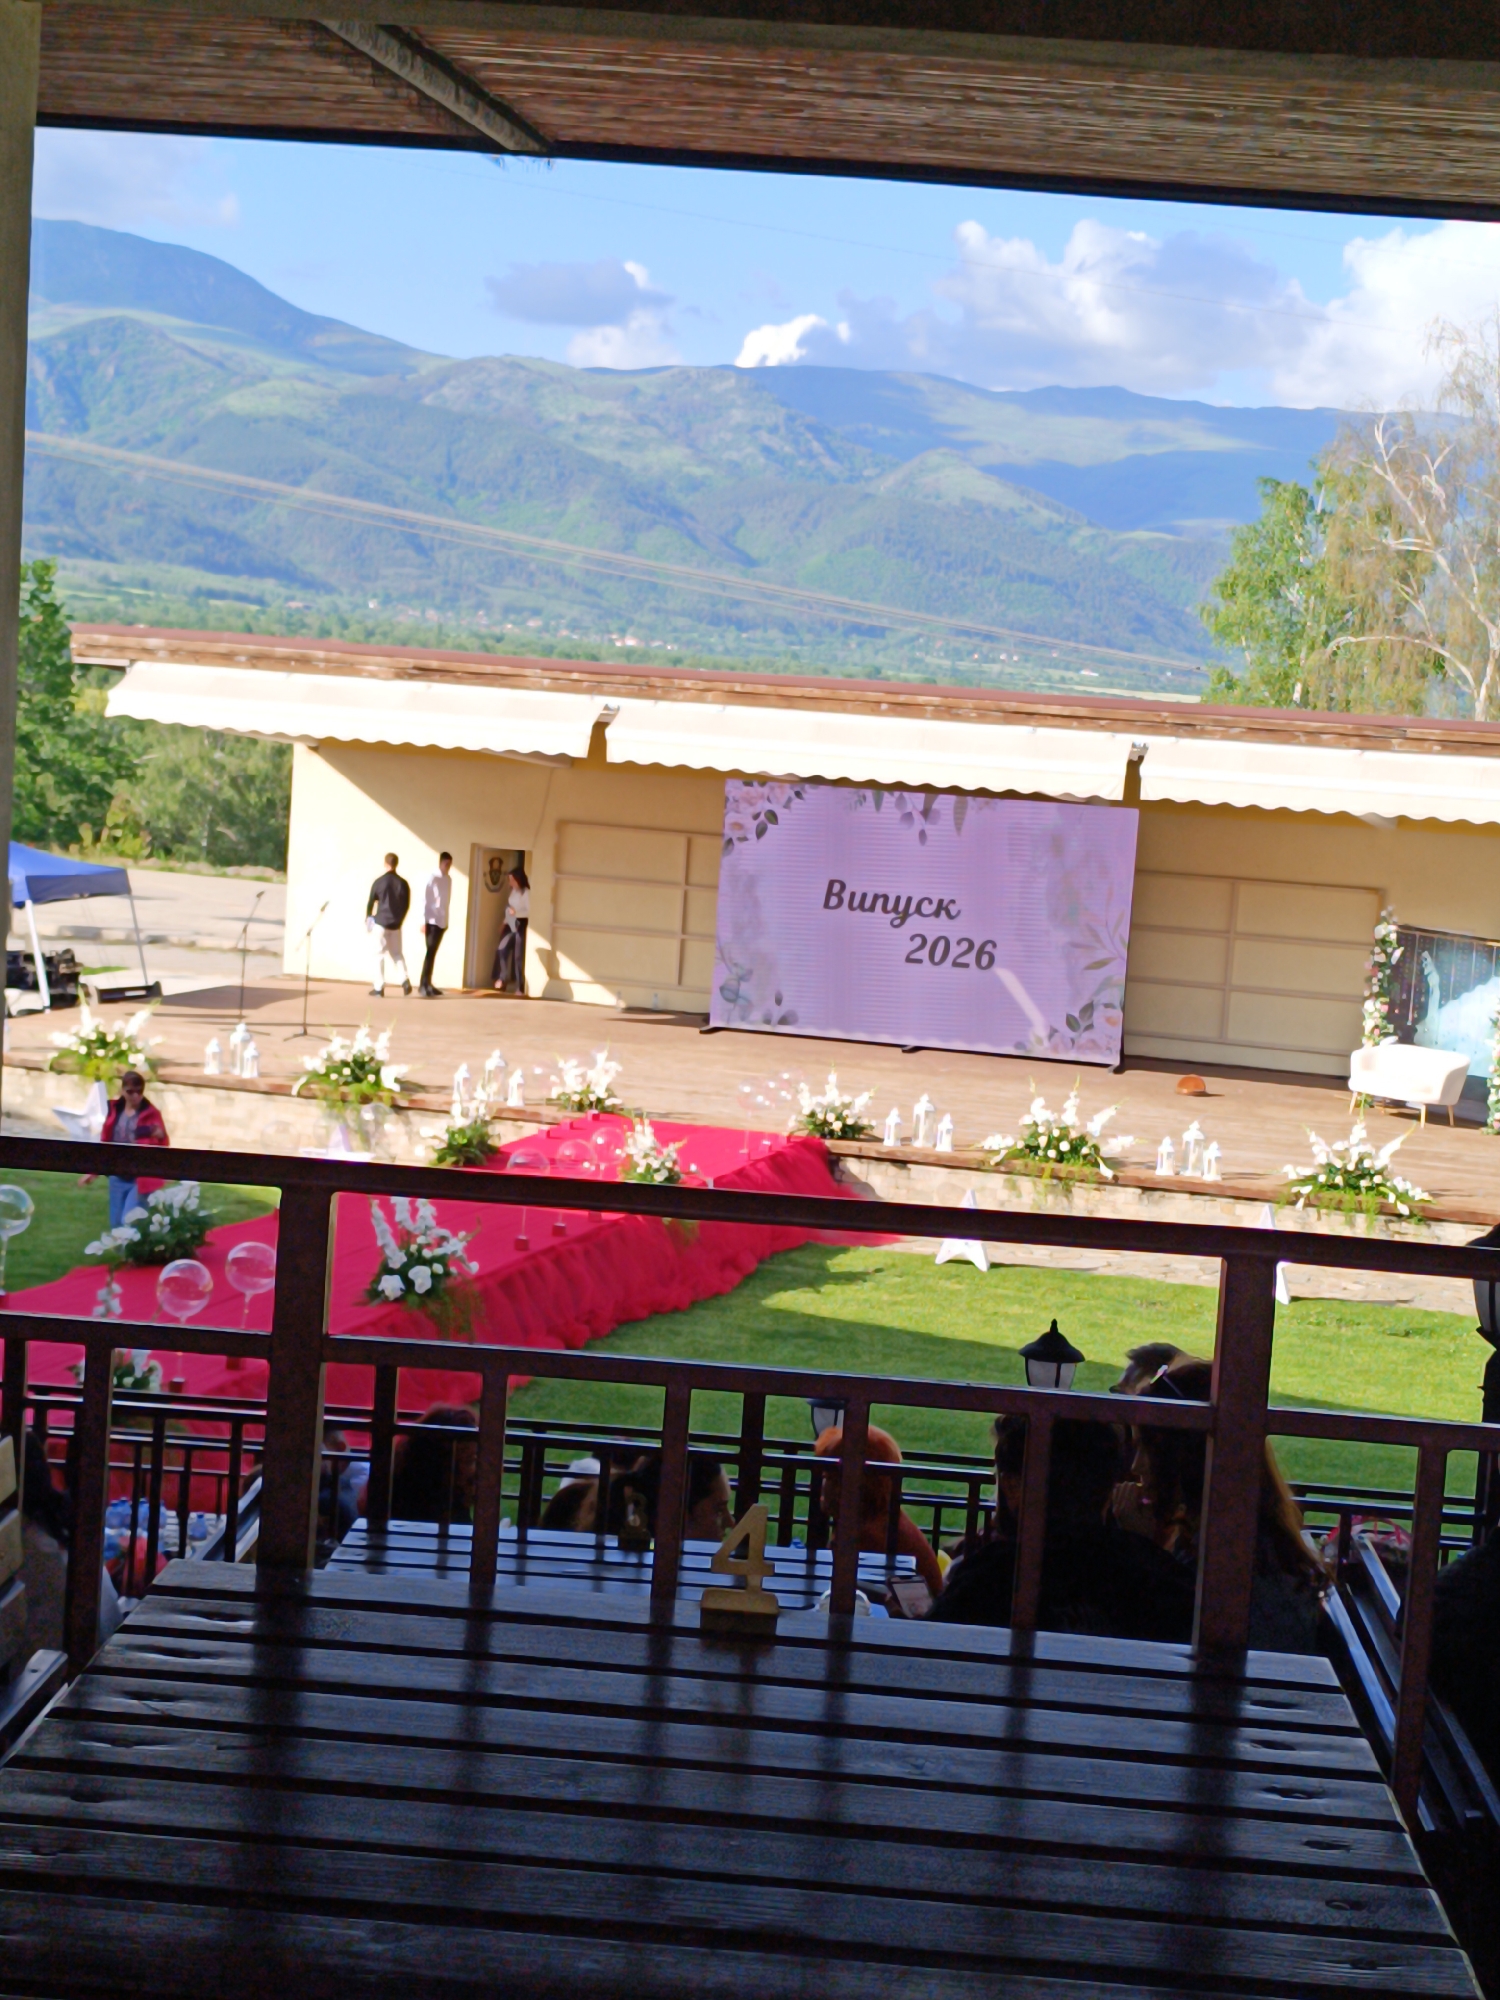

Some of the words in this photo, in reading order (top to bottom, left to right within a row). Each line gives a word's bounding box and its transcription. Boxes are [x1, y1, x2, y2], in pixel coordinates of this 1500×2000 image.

[823, 879, 961, 928] Випуск
[905, 933, 997, 970] 2026
[711, 1503, 775, 1593] 4
